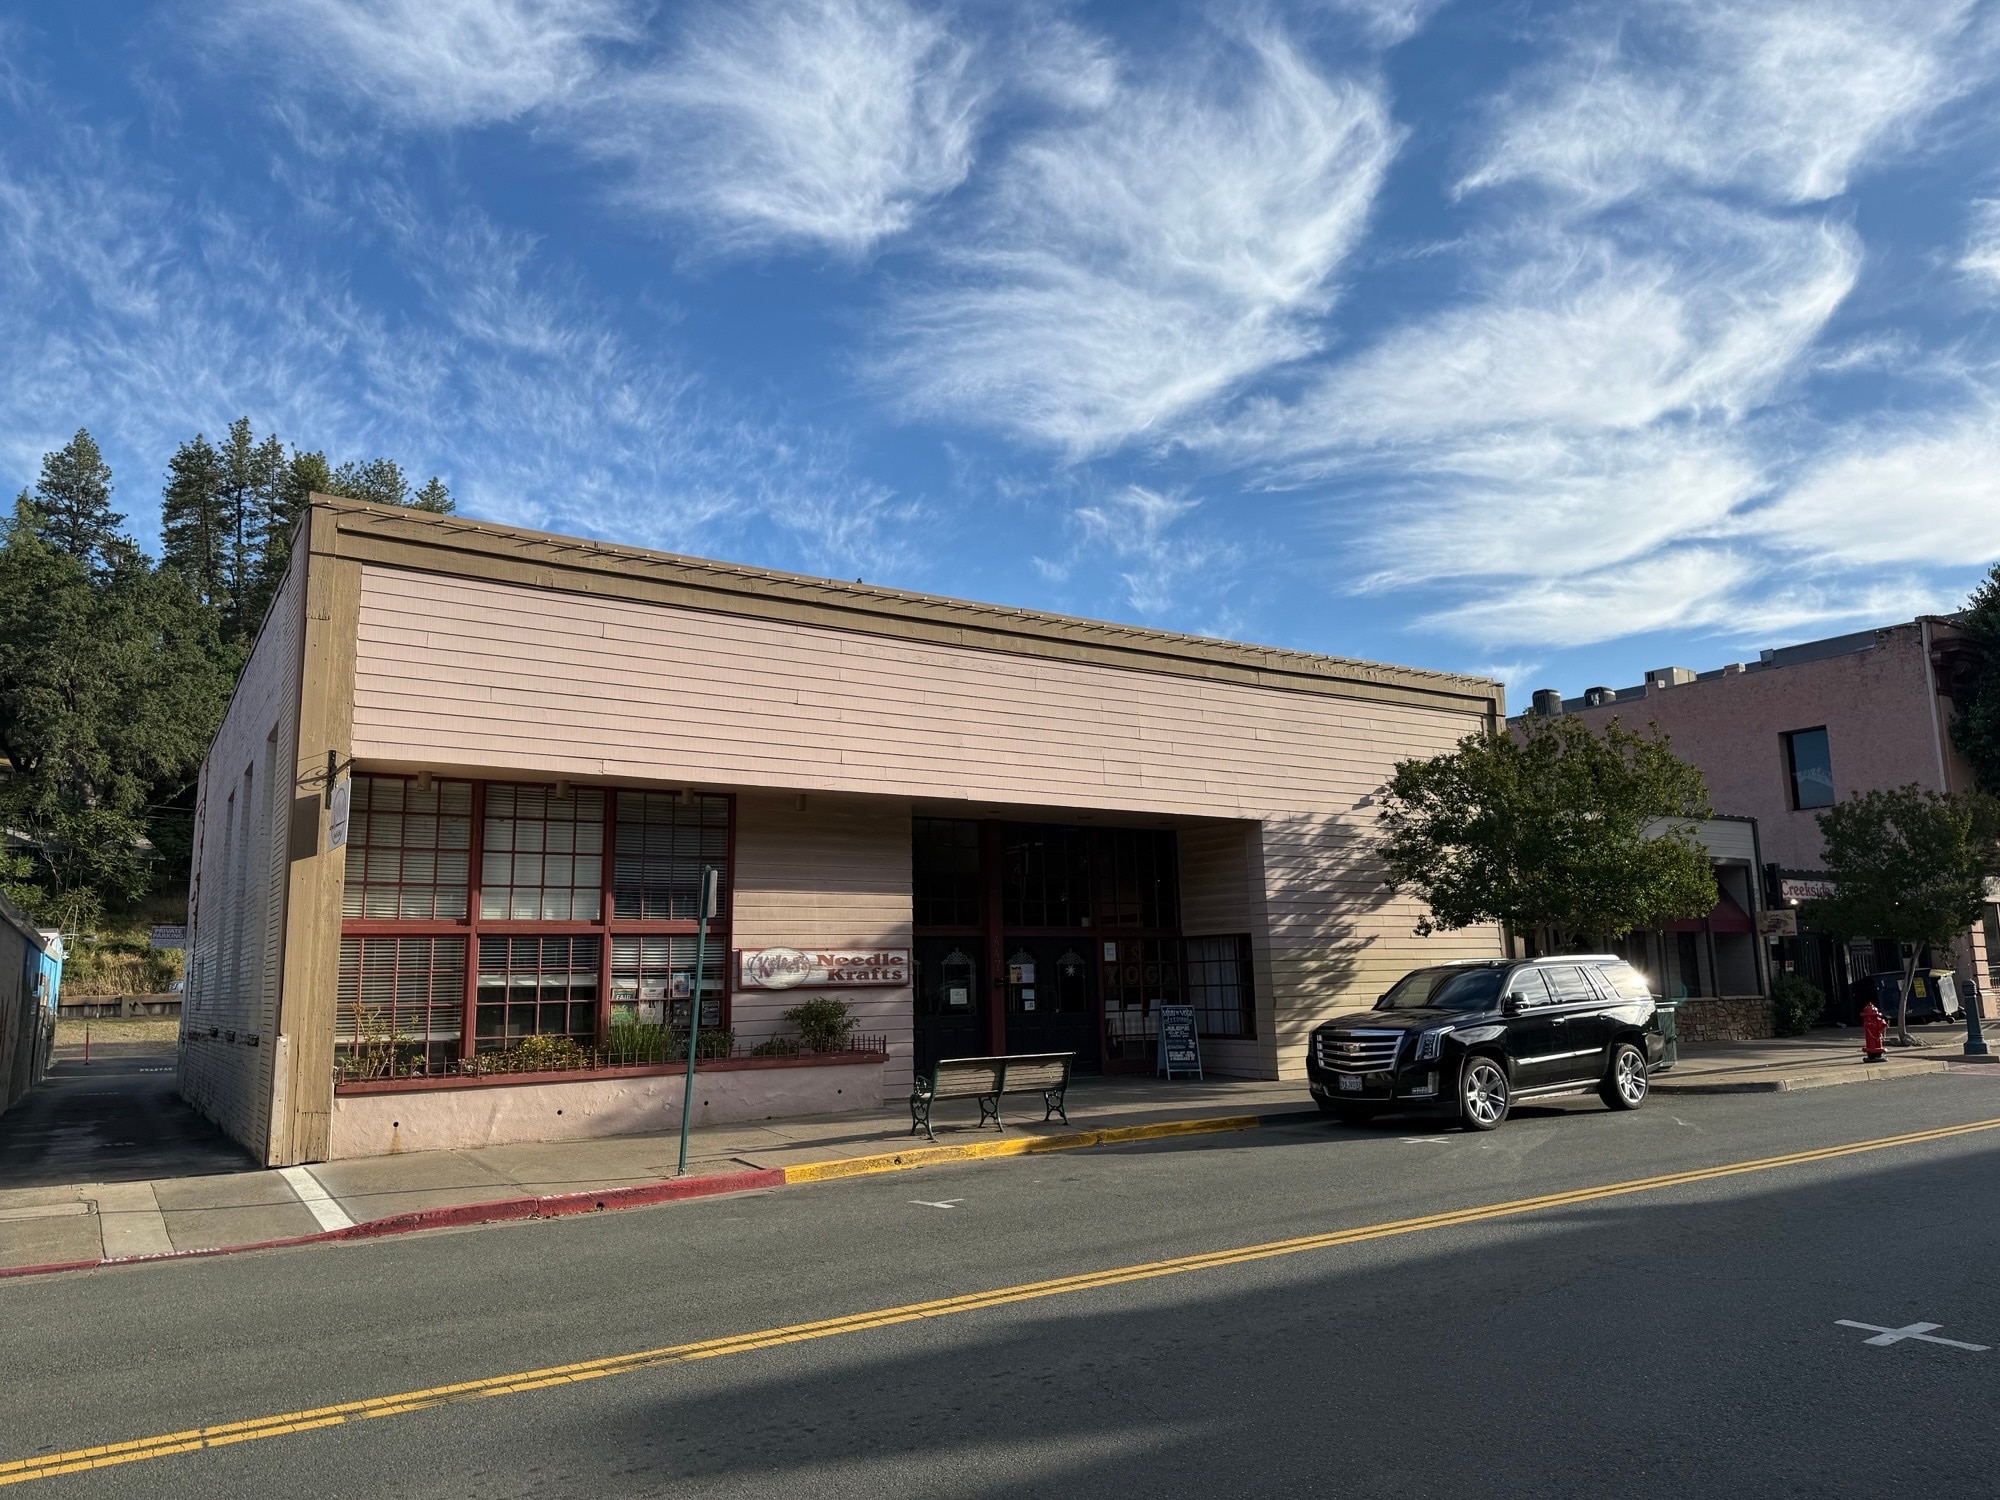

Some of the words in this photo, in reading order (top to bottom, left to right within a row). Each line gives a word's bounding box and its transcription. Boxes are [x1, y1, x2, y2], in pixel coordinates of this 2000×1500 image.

[816, 953, 904, 967] Needle
[827, 967, 903, 981] Krafts
[1103, 965, 1177, 985] YOGA
